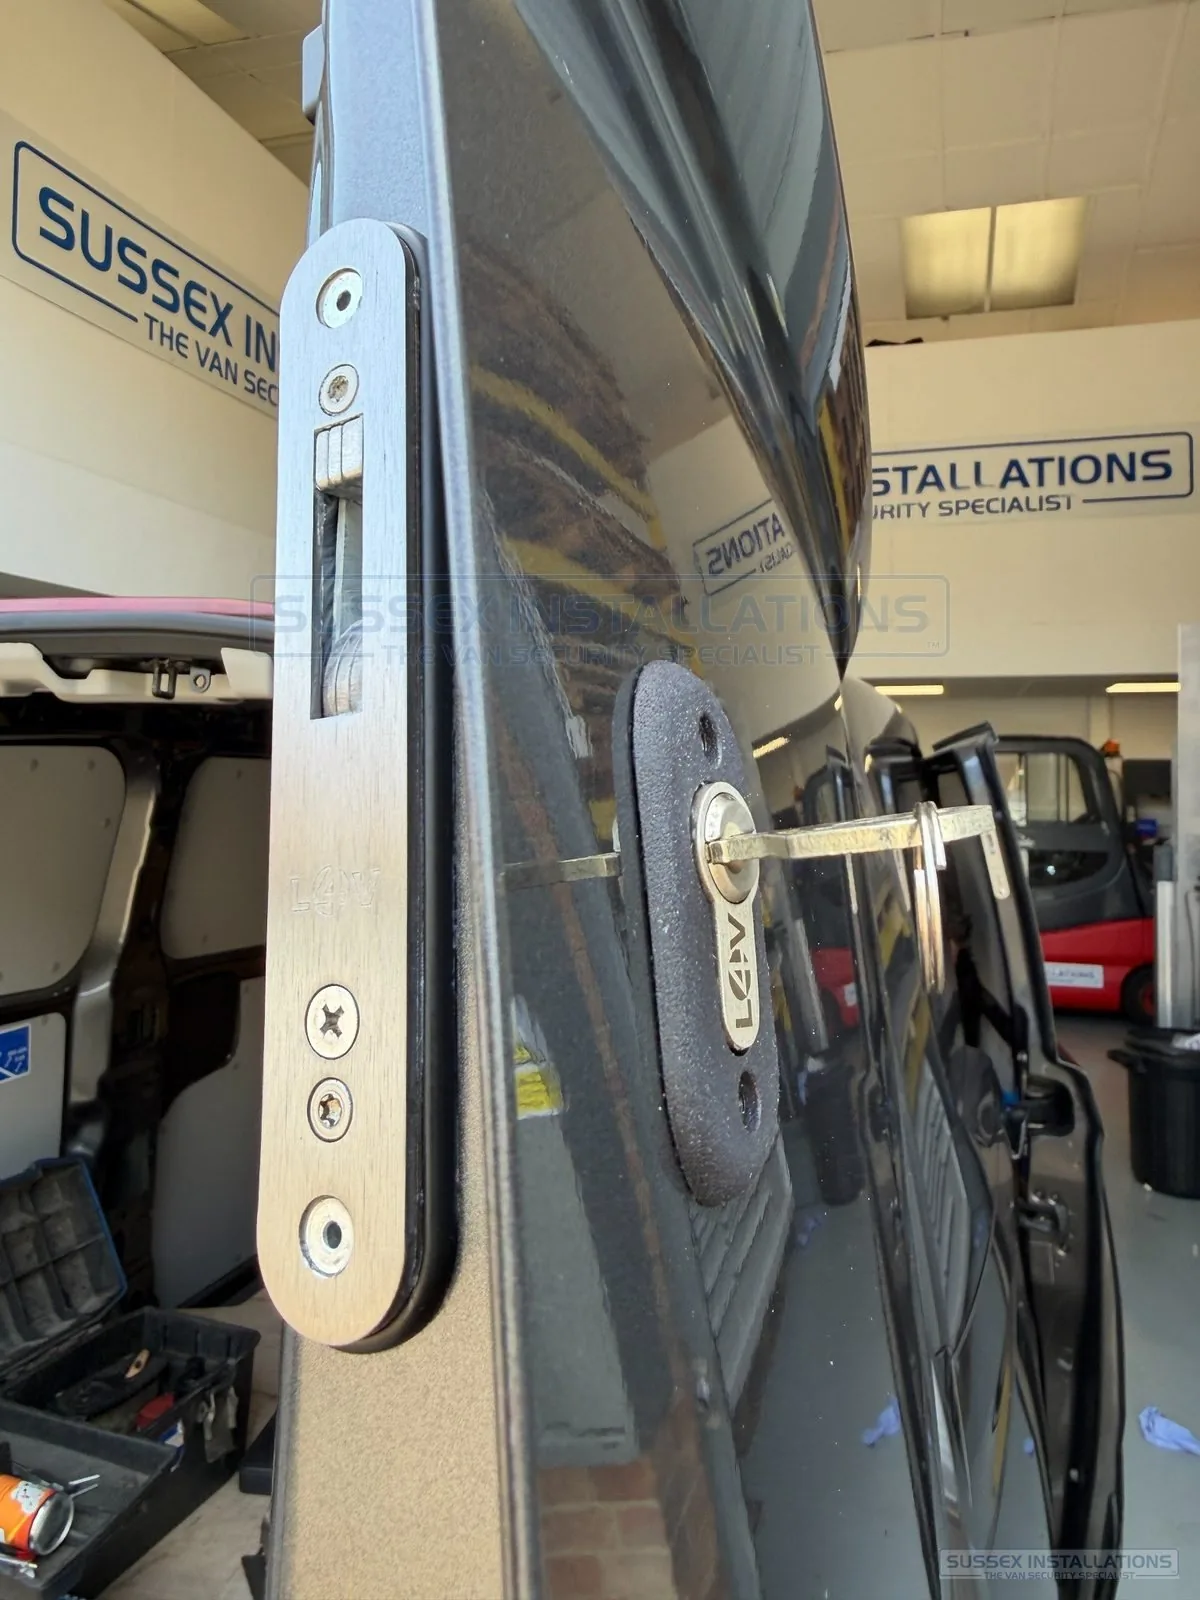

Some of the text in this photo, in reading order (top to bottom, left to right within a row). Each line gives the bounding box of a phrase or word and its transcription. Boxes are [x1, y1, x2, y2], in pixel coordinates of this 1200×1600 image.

[38, 186, 234, 348] SUSSEX
[143, 311, 189, 360] THE
[194, 339, 239, 386] VAN
[938, 494, 1072, 517] SPECIALIST
